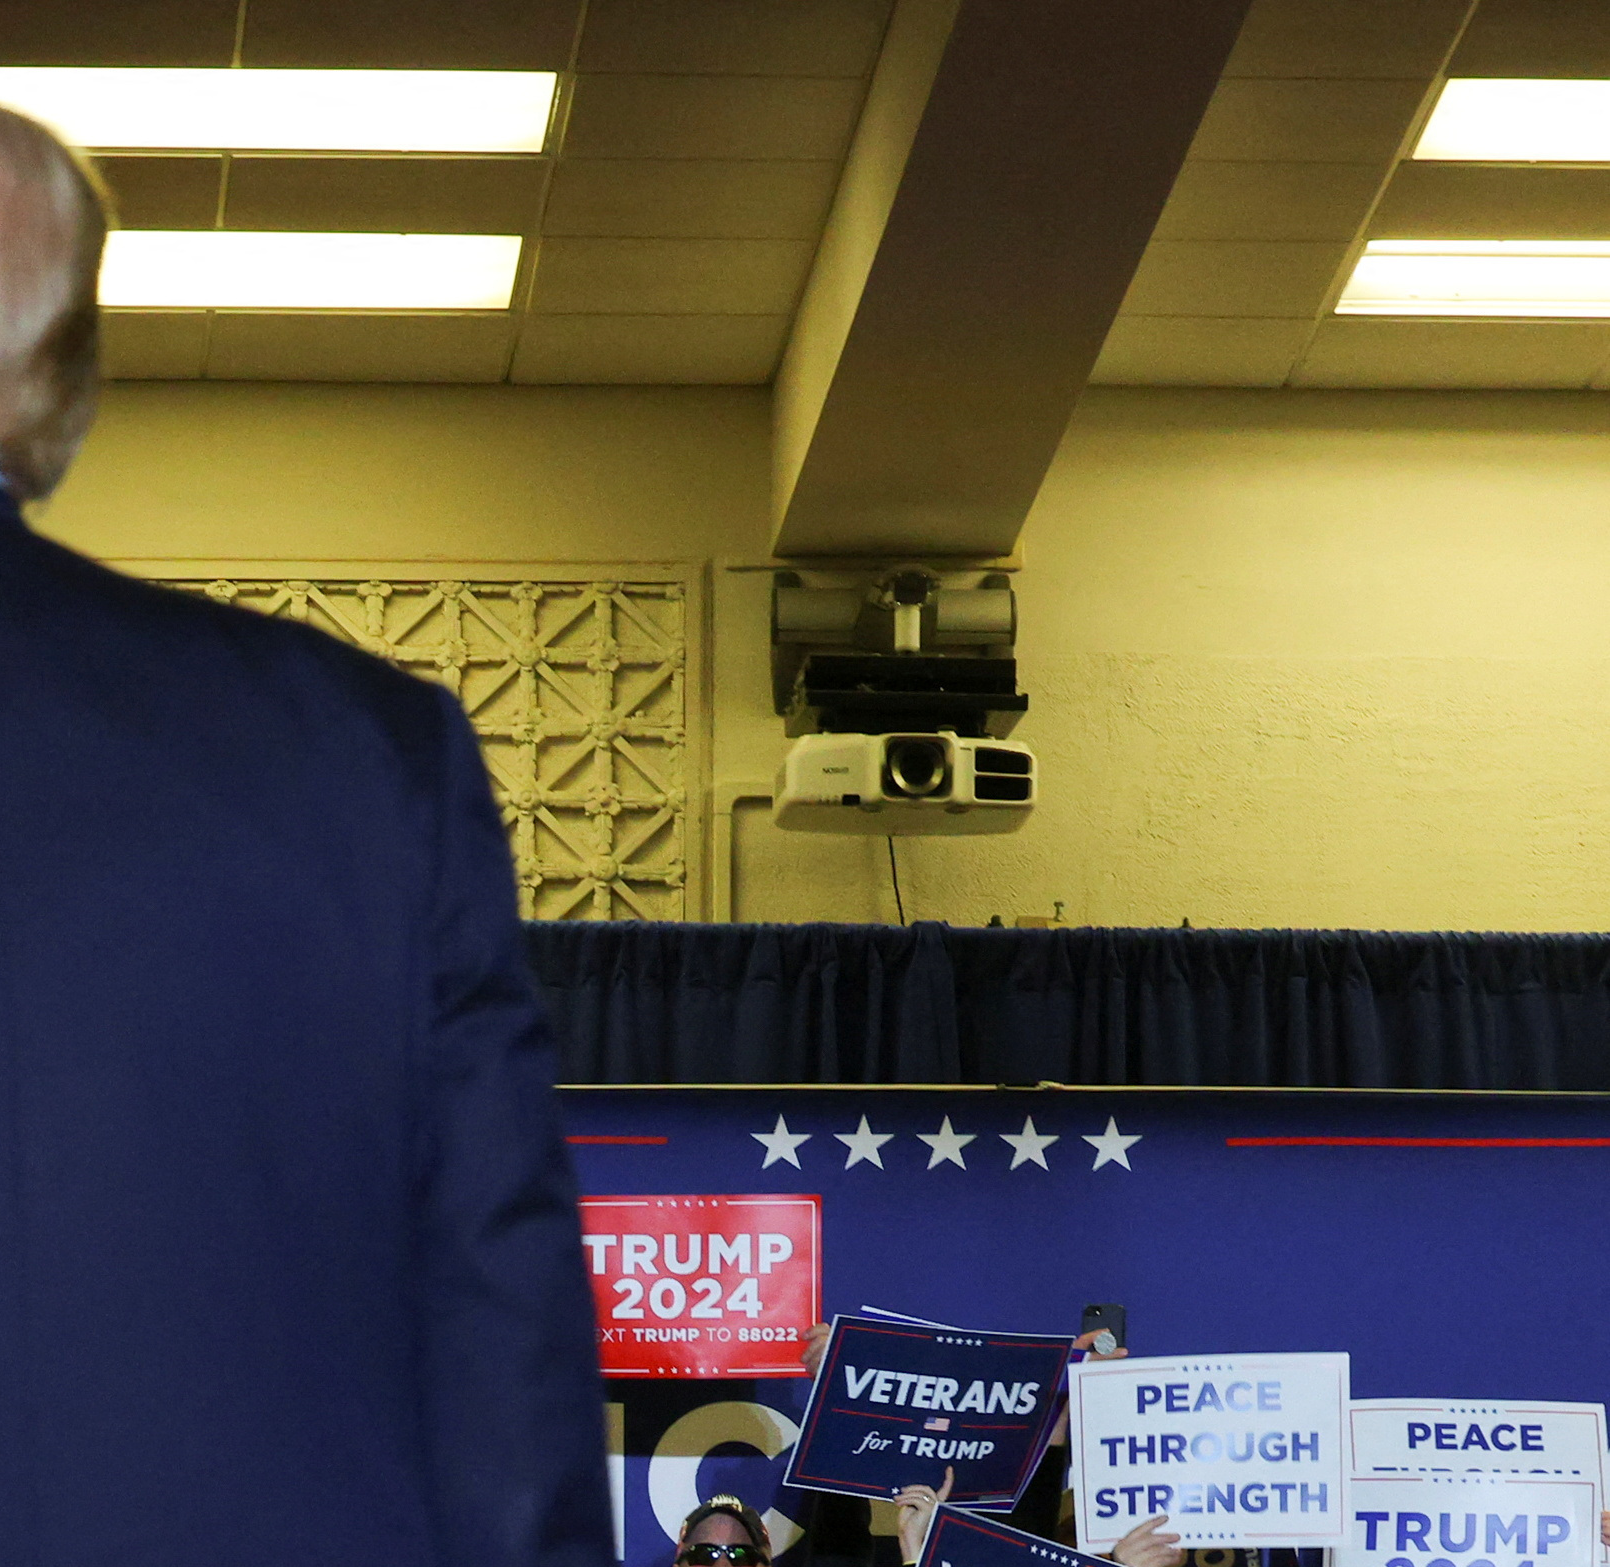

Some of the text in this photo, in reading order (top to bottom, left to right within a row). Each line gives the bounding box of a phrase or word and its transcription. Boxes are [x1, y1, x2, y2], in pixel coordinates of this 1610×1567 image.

[581, 1233, 795, 1276] TRUMP
[611, 1277, 763, 1320] 2024
[632, 1327, 798, 1343] TRUMP TO 88022
[843, 1365, 1040, 1416] VETERANS
[1136, 1381, 1281, 1415] PEACE
[853, 1431, 996, 1460] for TRUMP
[1100, 1432, 1320, 1467] THROUGH
[1407, 1421, 1545, 1452] PEACE
[1094, 1482, 1329, 1518] STRENGTH
[1355, 1510, 1572, 1556] TRUMP
